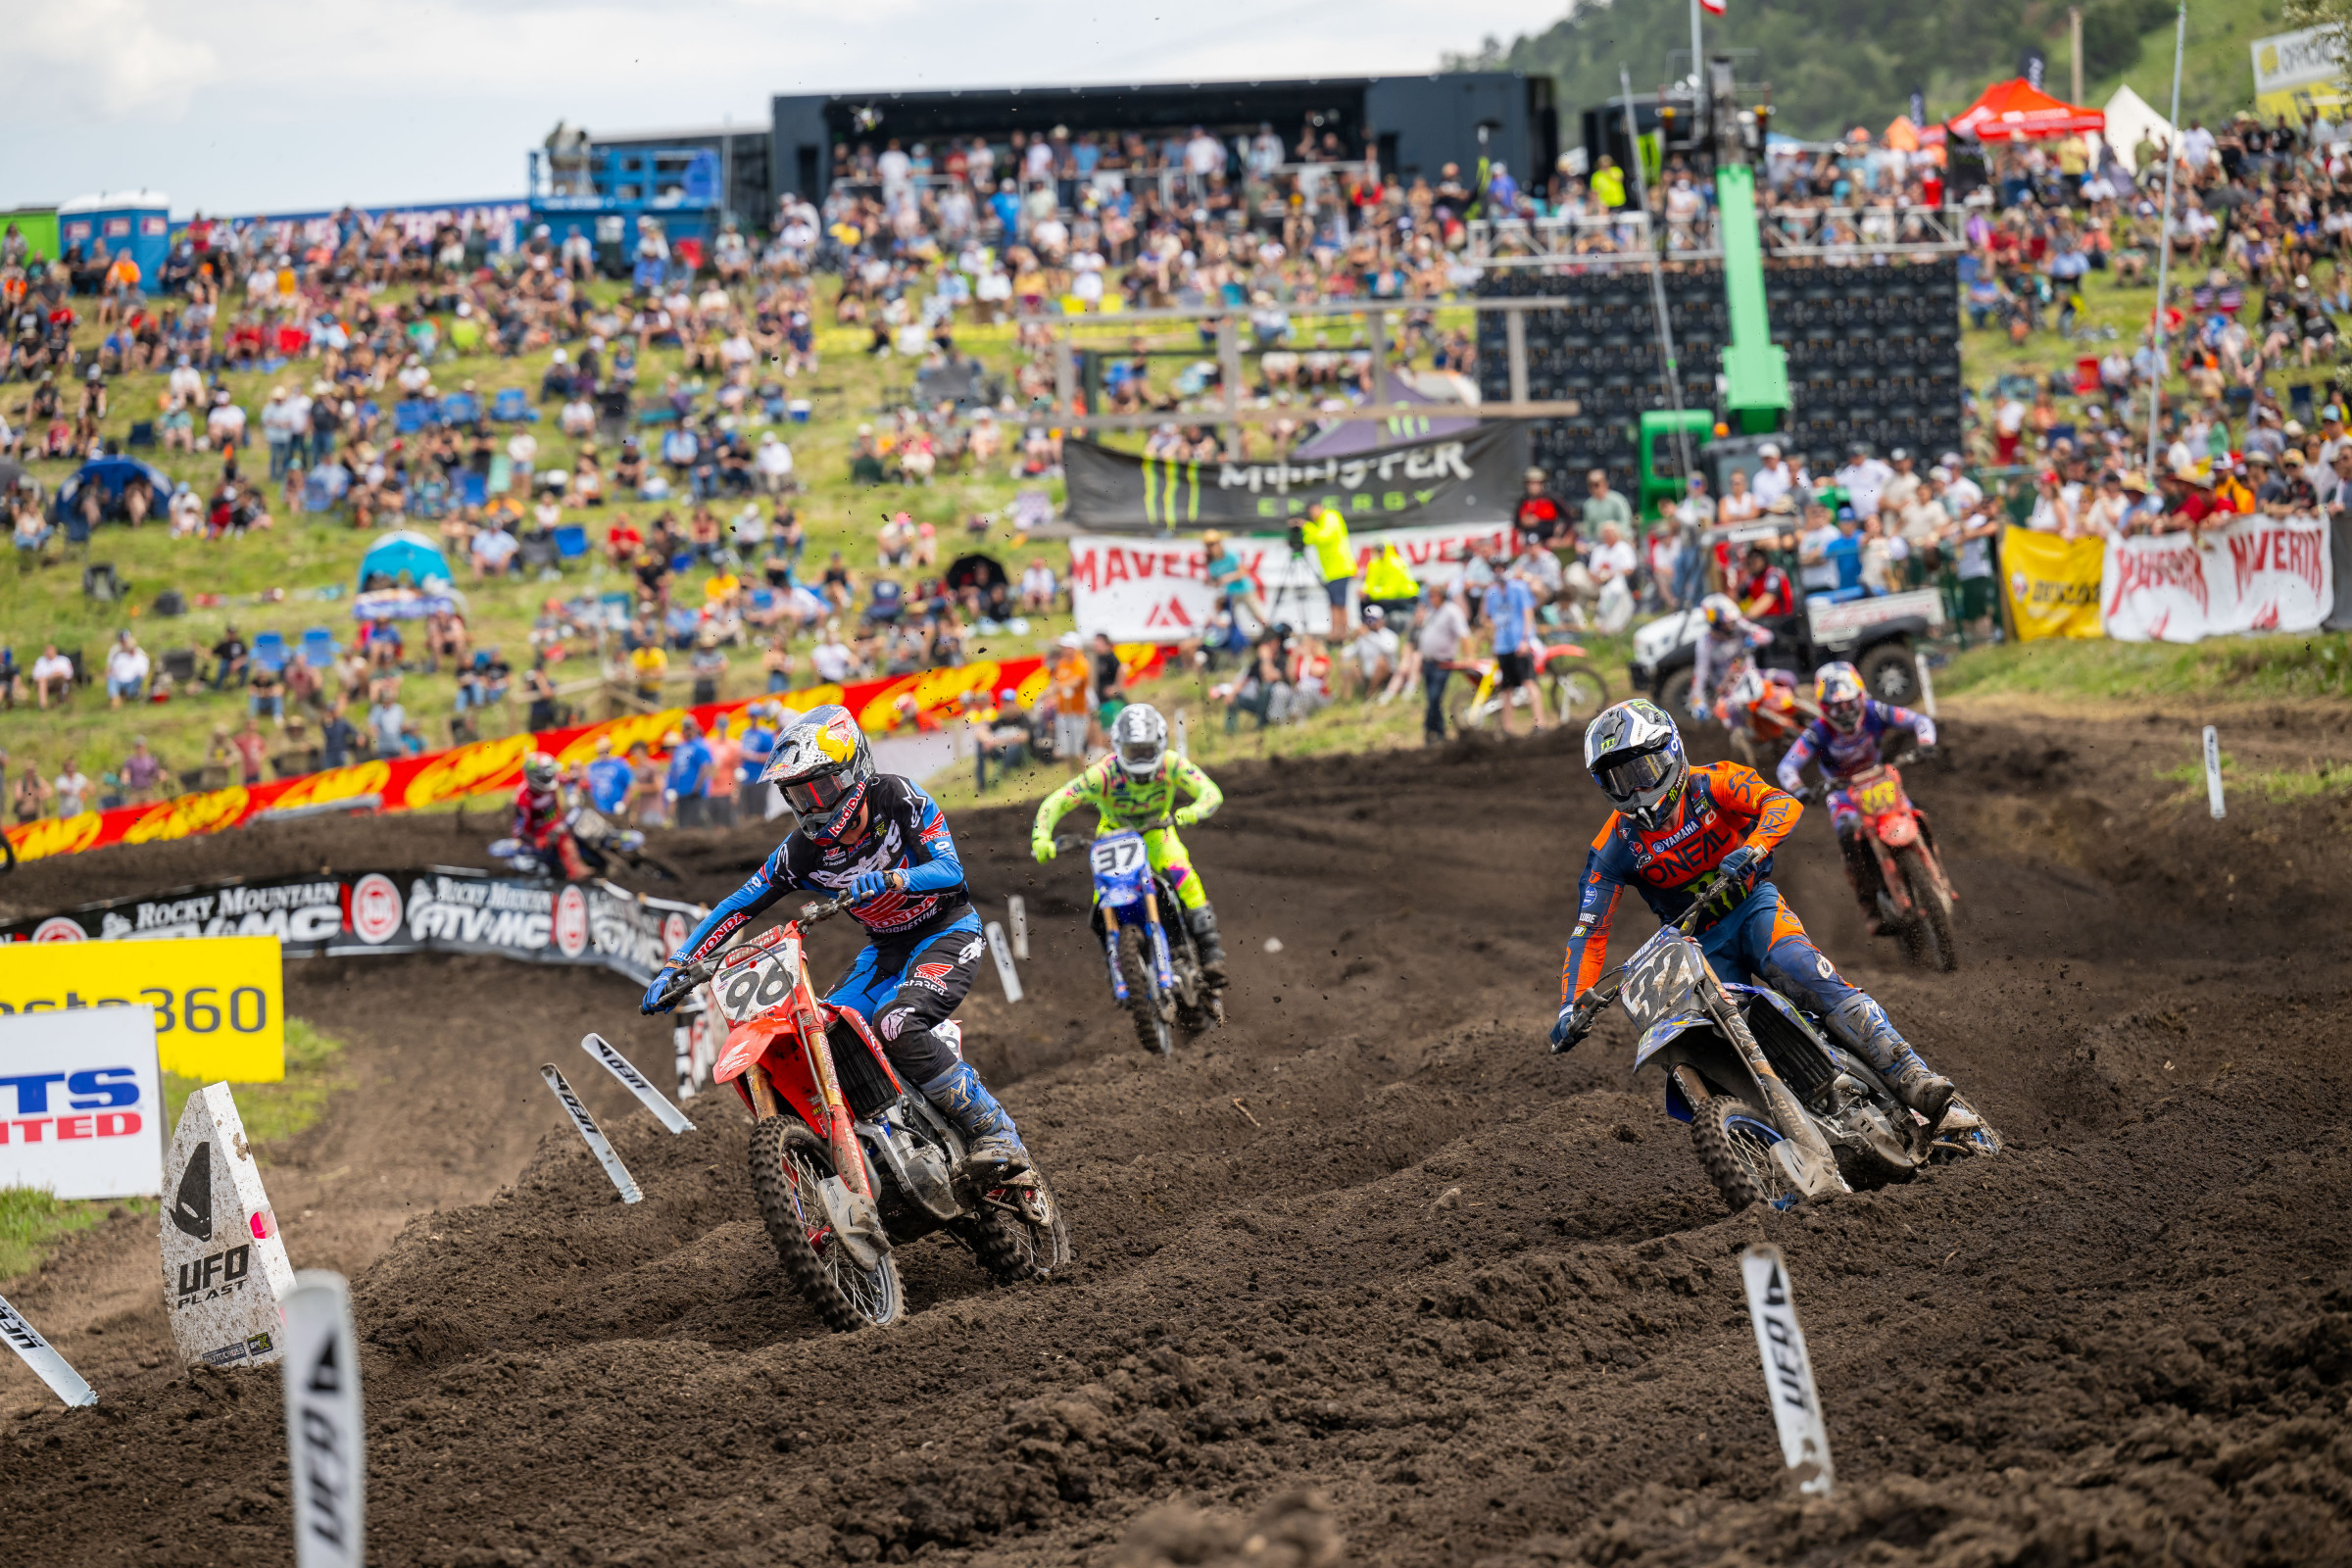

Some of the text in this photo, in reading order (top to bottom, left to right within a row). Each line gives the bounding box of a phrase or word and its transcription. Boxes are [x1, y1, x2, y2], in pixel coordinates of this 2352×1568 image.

[1071, 548, 1265, 603] MAVERK
[828, 807, 852, 837] Red
[847, 781, 866, 811] Bull
[921, 831, 951, 845] HONDA
[1097, 842, 1139, 873] 37
[1662, 820, 1699, 849] YAMAHA
[135, 896, 217, 930] ROCKY
[219, 882, 341, 917] MOUNTAIN
[692, 911, 753, 961] HONDA
[726, 962, 795, 1025] 96
[914, 972, 948, 990] HONDA
[1627, 943, 1700, 1027] 32
[606, 1058, 648, 1089] UFO
[562, 1095, 599, 1134] UFO
[177, 1279, 247, 1309] PLAST
[178, 1244, 250, 1297] UFO
[1764, 1313, 1805, 1410] UFO
